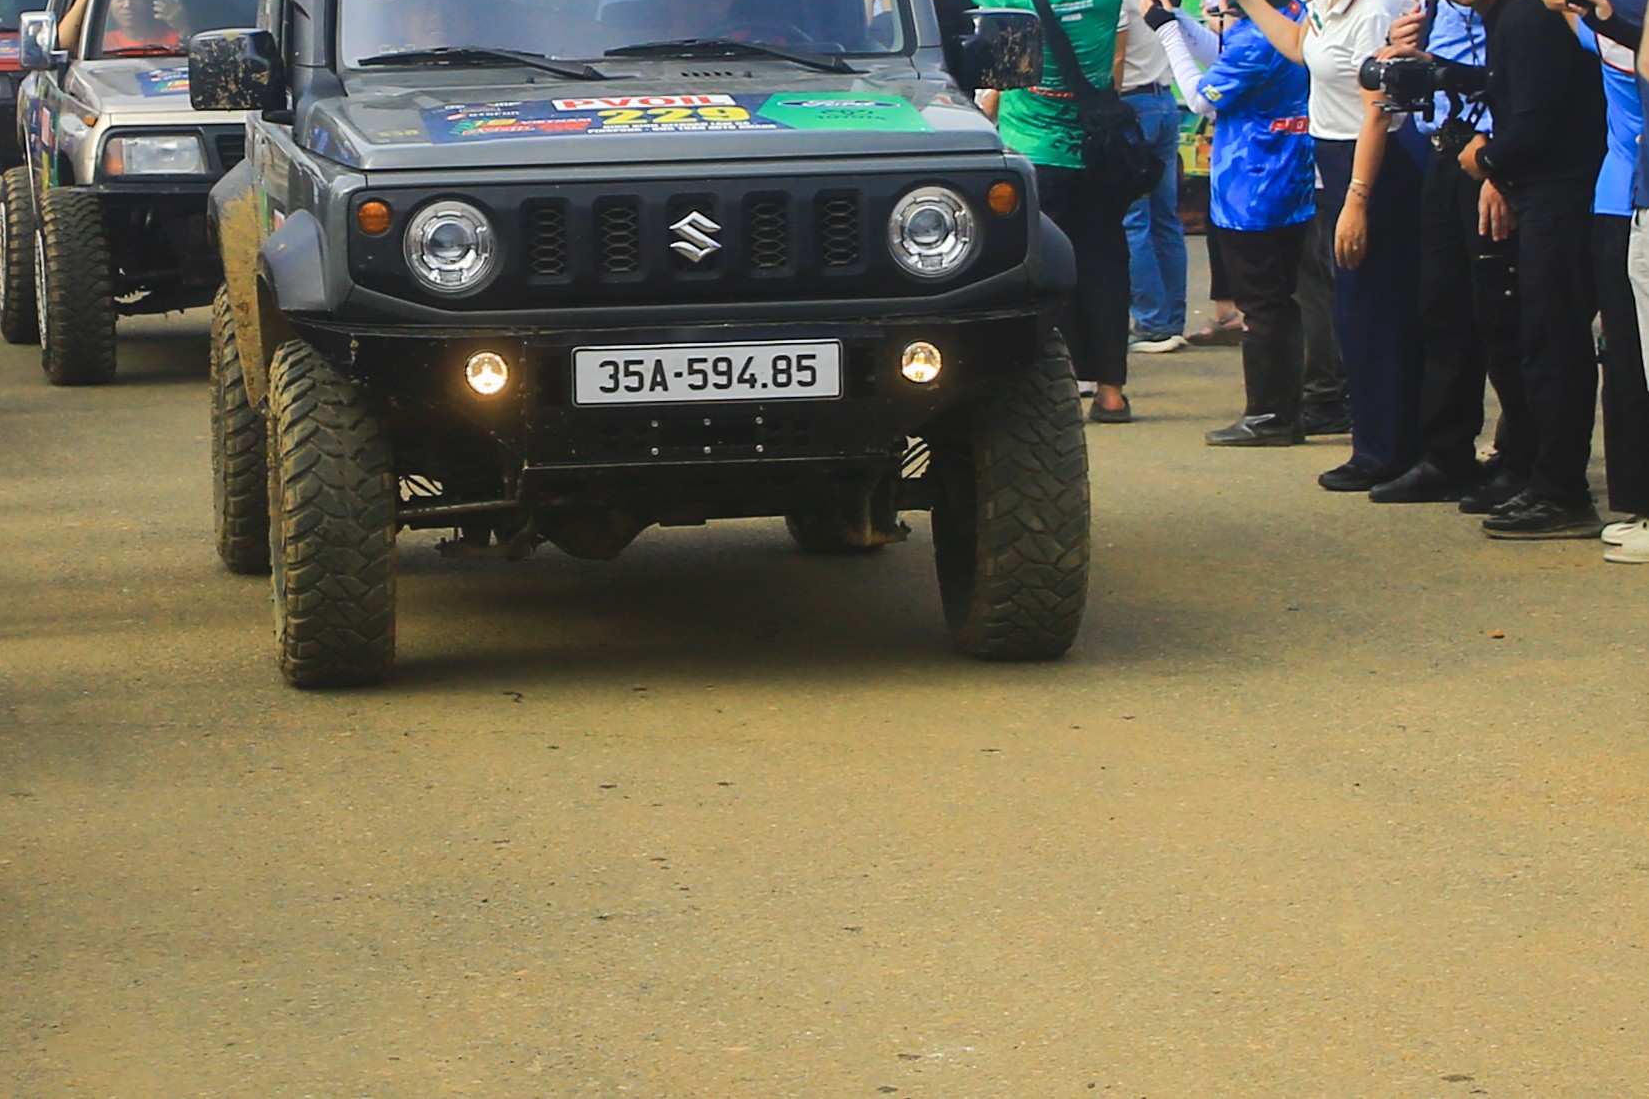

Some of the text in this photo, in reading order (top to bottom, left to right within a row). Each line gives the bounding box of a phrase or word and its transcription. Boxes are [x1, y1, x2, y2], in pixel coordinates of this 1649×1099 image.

[561, 96, 723, 109] PVOIL
[596, 106, 751, 125] 229
[598, 352, 818, 395] 35A-594.85
